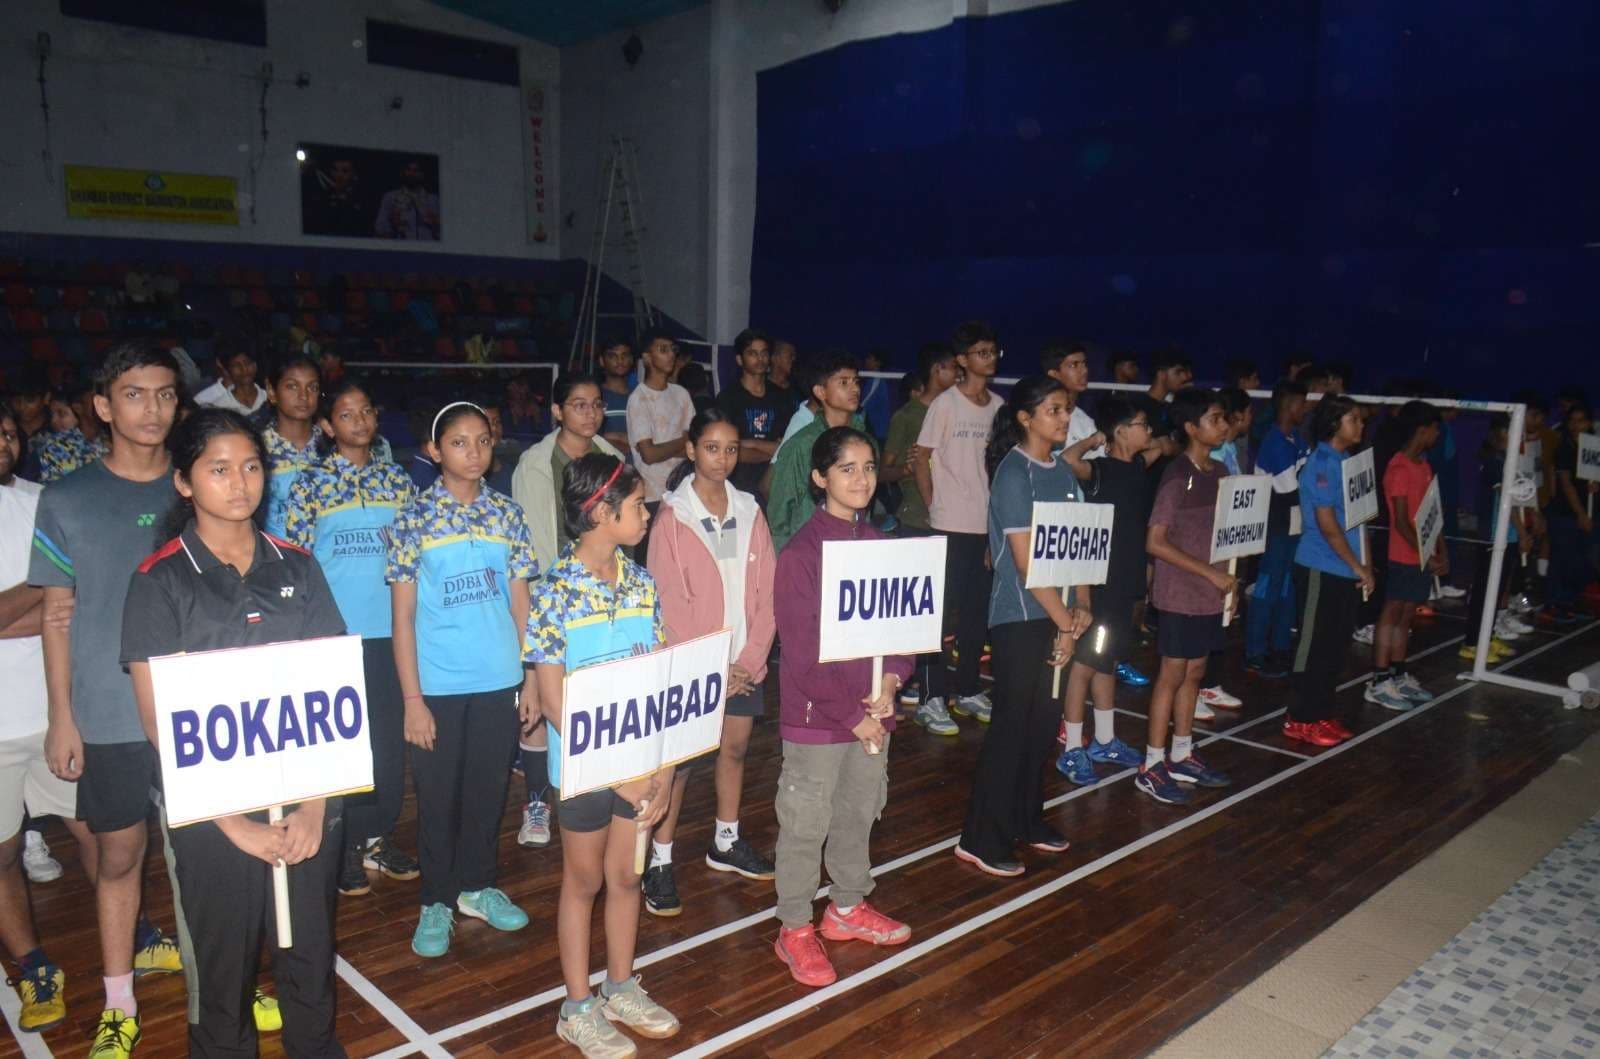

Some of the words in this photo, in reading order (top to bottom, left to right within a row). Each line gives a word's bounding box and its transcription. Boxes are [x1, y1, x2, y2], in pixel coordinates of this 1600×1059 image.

[530, 116, 545, 213] WELCOME
[1233, 489, 1256, 509] EAST
[1348, 468, 1374, 502] GUMLA
[333, 532, 375, 546] DDBA
[1034, 525, 1109, 560] DEOGHAR
[1216, 523, 1265, 548] SINGHBHUM
[444, 575, 483, 594] DDBA
[838, 576, 935, 621] DUMKA
[171, 686, 362, 768] BOKARO
[569, 672, 722, 757] DHANBAD
